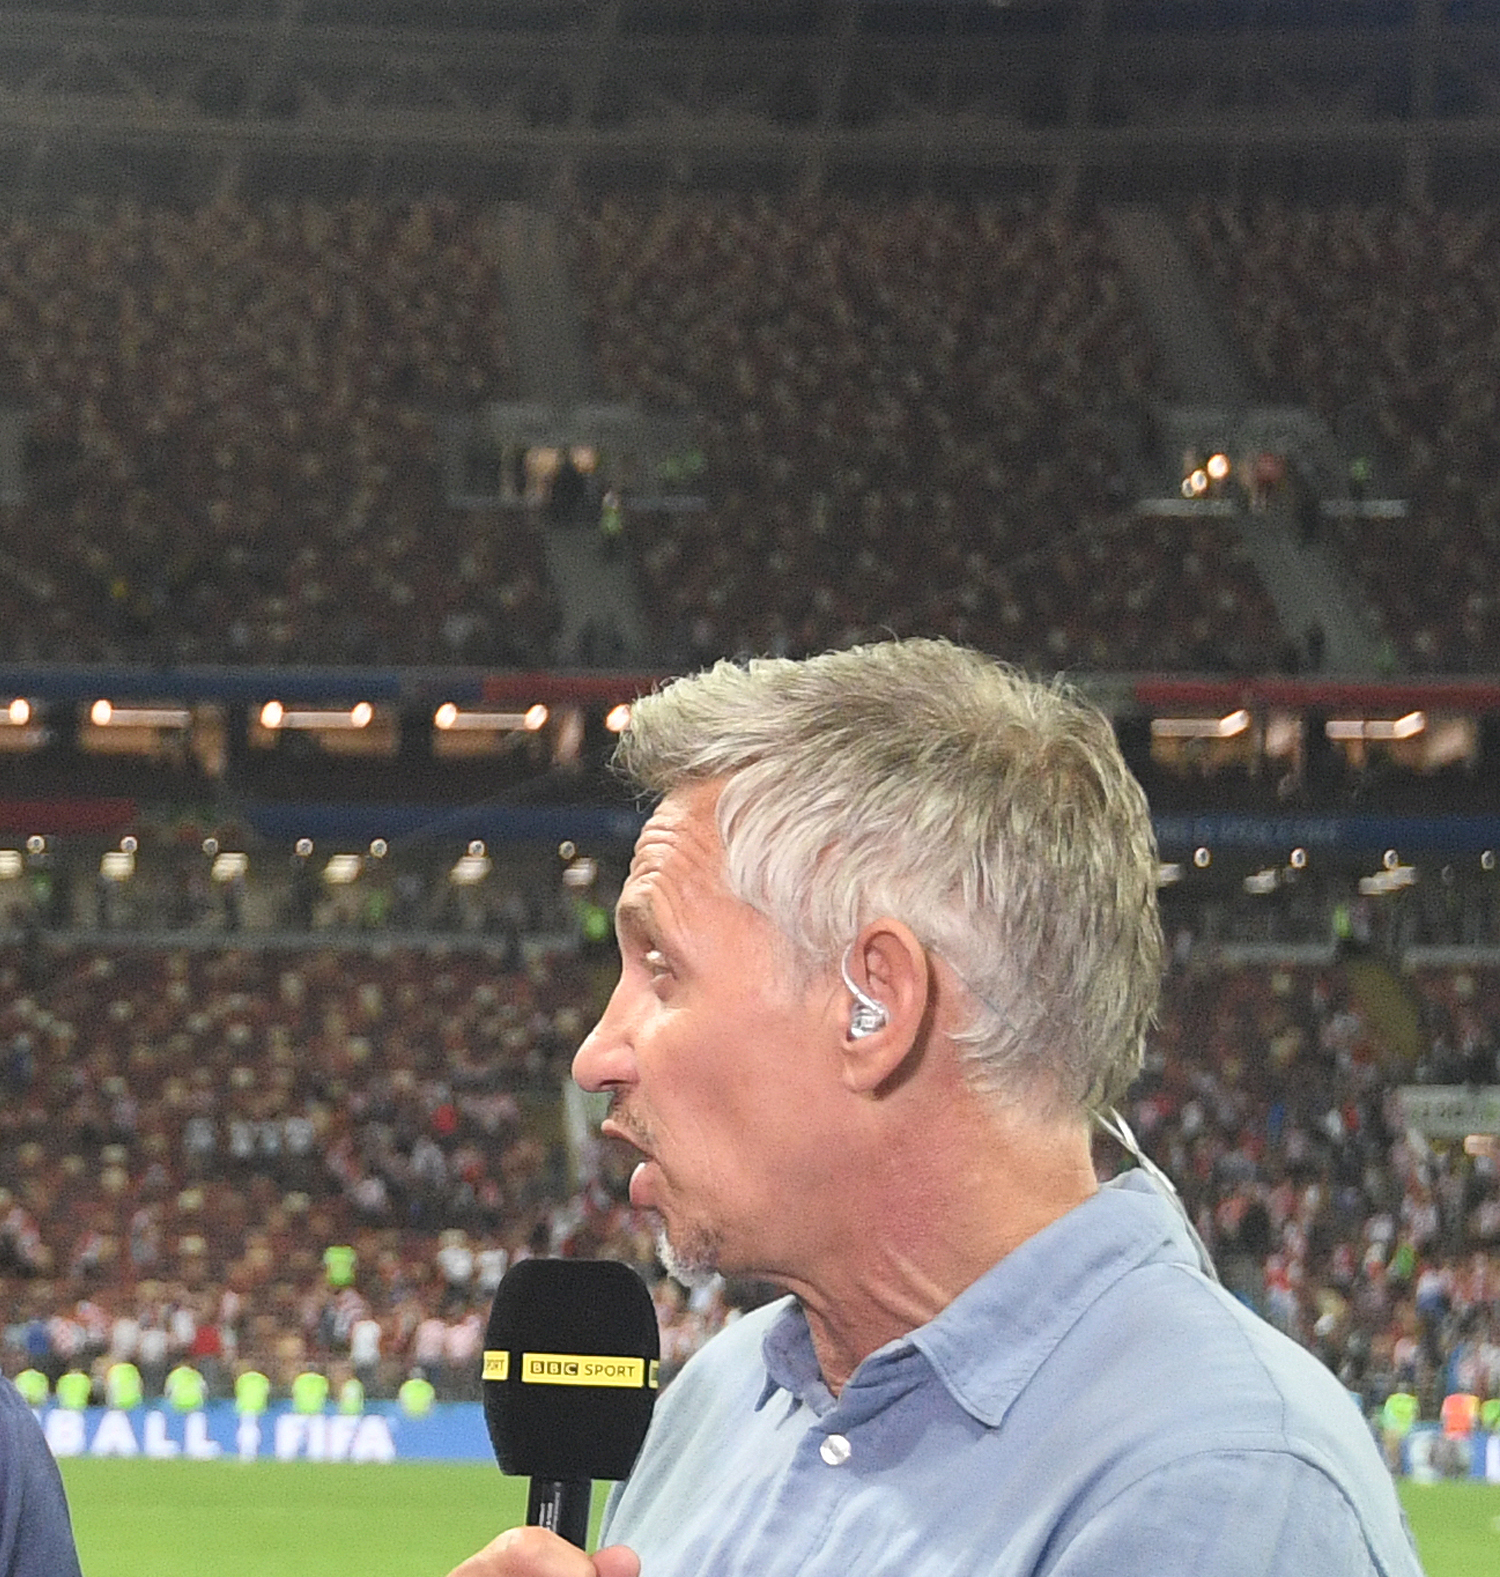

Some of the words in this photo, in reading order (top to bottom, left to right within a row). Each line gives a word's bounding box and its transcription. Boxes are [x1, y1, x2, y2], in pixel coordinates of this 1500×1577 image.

[530, 1360, 579, 1376] BBC
[584, 1363, 636, 1378] SPORT
[32, 1408, 224, 1459] BALL
[274, 1413, 396, 1463] FIFA
